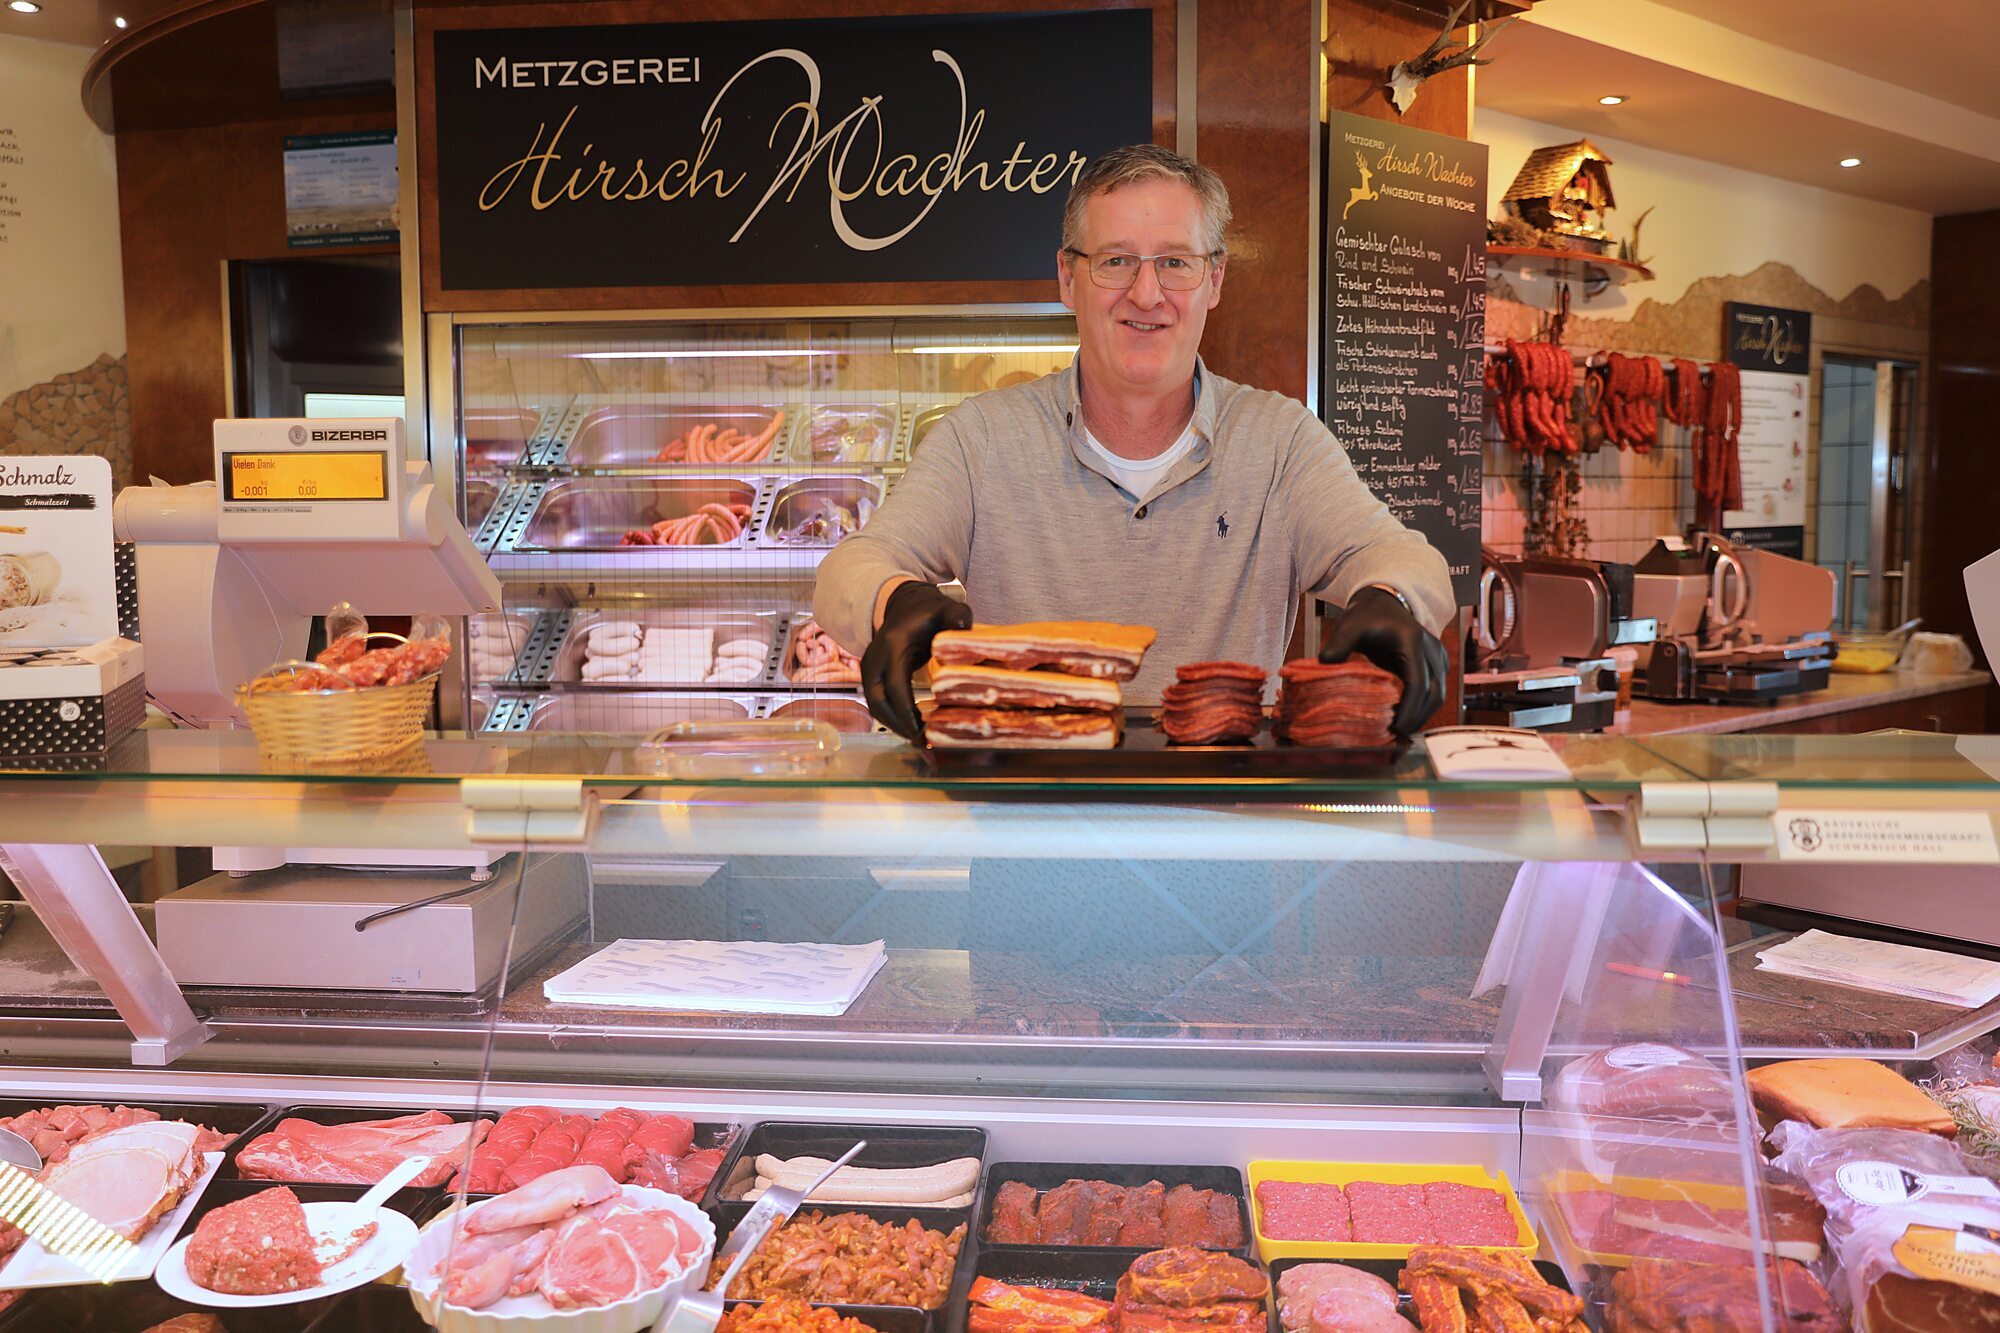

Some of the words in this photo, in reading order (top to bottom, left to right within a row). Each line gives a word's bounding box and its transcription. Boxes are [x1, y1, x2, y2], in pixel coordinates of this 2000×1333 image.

[475, 56, 701, 89] METZGEREI
[478, 104, 747, 211] Hirsch
[769, 96, 1087, 204] Wachter
[1376, 144, 1423, 176] Hirsch
[1424, 151, 1476, 188] Wachter
[1379, 183, 1425, 203] ANGEBOTE
[1427, 194, 1444, 207] DER
[1445, 196, 1476, 213] WOCHE
[1335, 226, 1388, 253] Gemischter
[1335, 250, 1359, 271] Rind
[311, 430, 387, 441] BIZERBA
[0, 464, 76, 487] Schmalz
[24, 498, 70, 506] Schmalzzeit
